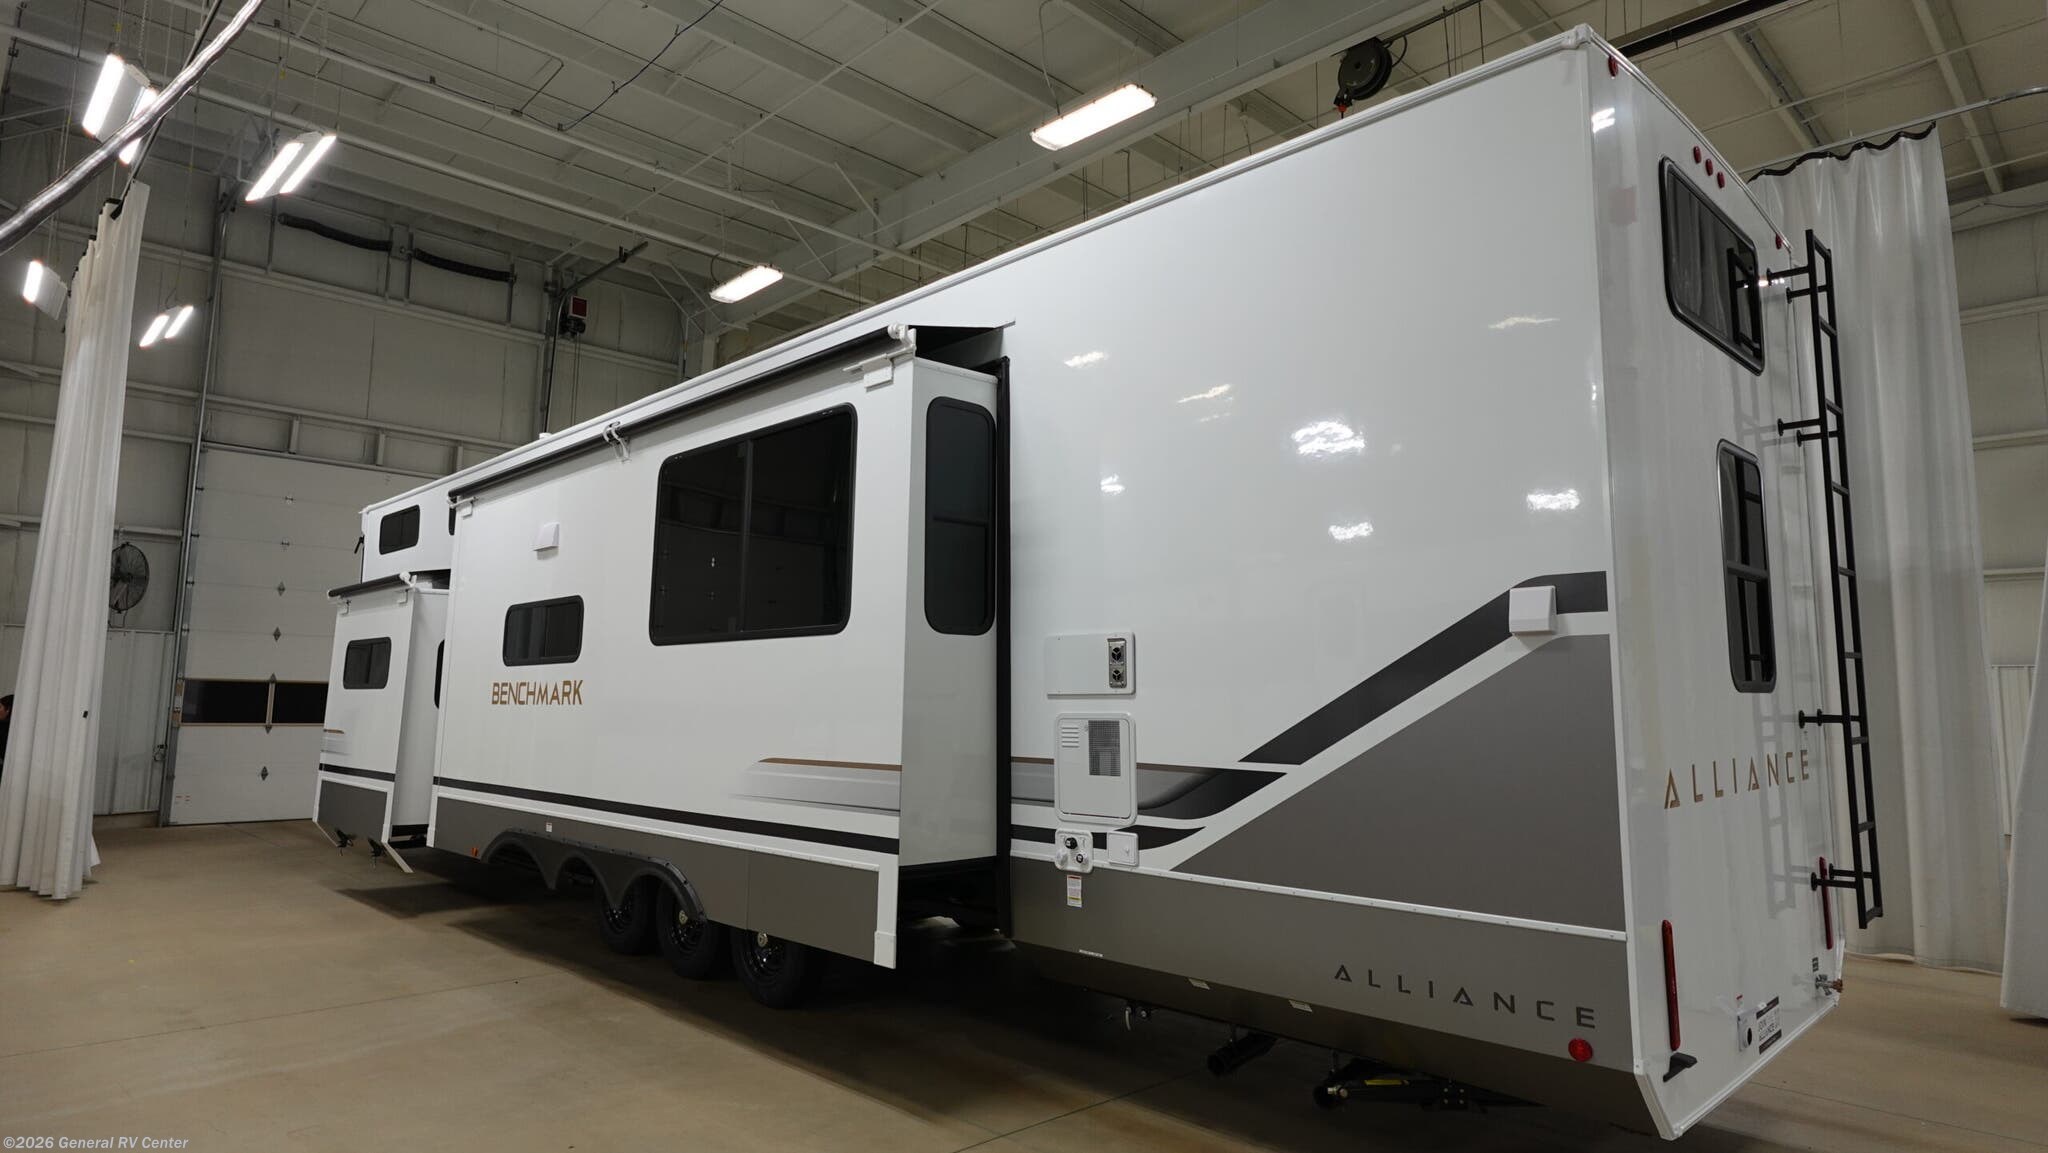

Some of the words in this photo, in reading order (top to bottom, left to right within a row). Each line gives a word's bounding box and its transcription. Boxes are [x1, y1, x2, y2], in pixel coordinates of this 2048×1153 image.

[491, 680, 583, 705] BENCHMARK
[1664, 749, 1810, 810] ALLIANCE
[1334, 964, 1596, 1029] ALLIANCE
